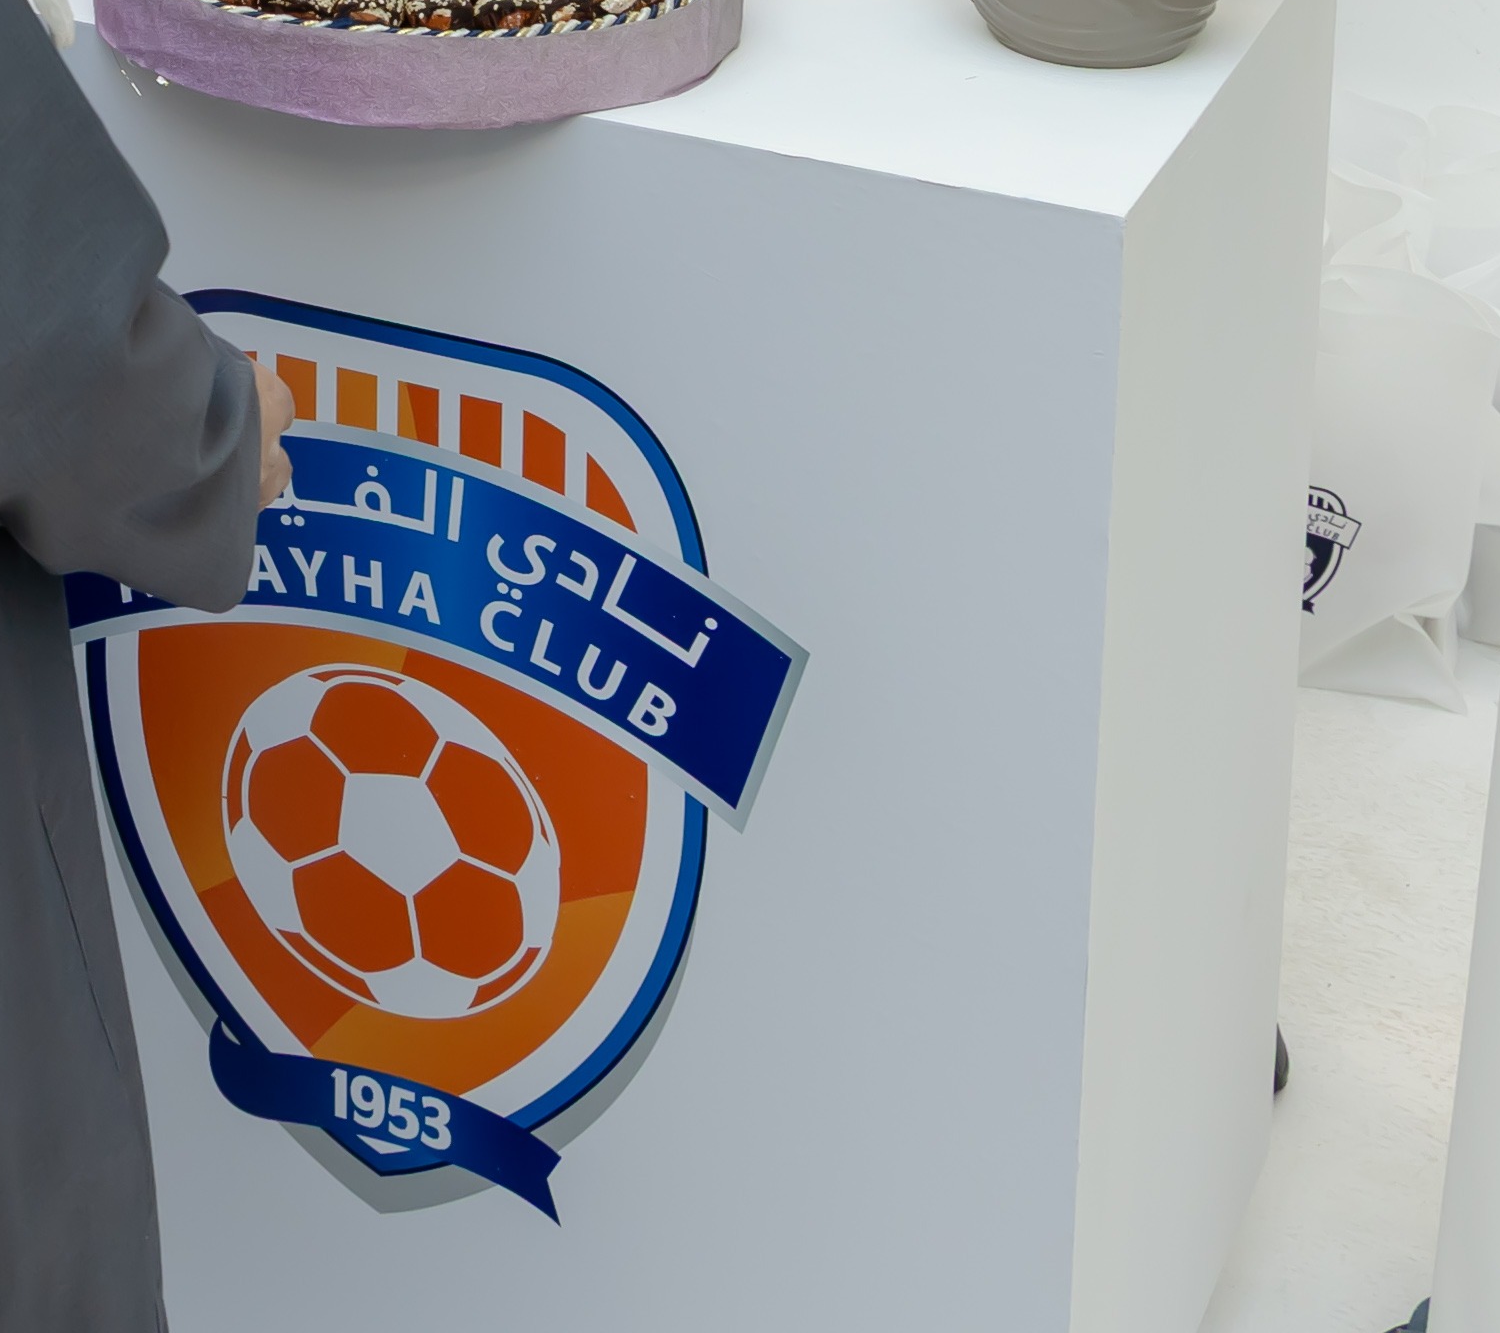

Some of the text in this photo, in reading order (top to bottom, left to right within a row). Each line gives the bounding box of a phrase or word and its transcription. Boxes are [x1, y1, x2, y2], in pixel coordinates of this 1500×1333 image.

[1306, 523, 1340, 541] CLUB
[486, 532, 719, 669] نادي
[480, 600, 679, 737] CLUB
[330, 1068, 452, 1151] 1953
